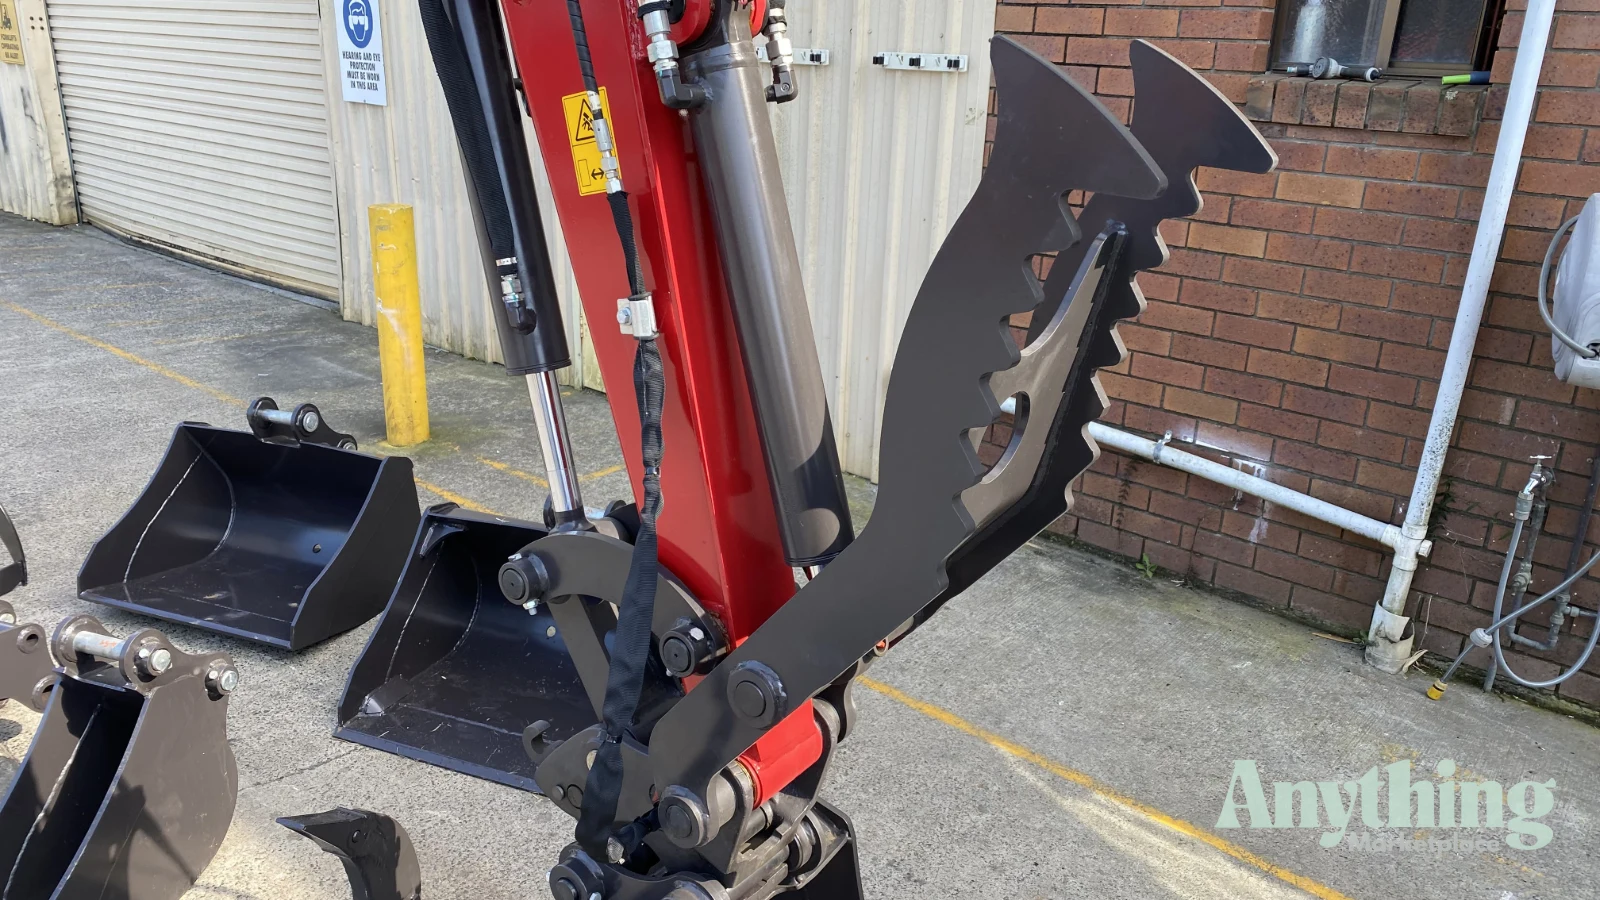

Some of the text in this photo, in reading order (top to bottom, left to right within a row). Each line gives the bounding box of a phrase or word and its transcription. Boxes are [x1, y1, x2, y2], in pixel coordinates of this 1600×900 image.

[342, 51, 361, 60] HEARING
[363, 52, 372, 61] AND
[350, 61, 376, 71] PROTECTION
[347, 70, 359, 79] MUST
[360, 71, 366, 80] BE
[351, 80, 378, 91] IN THIS AREA
